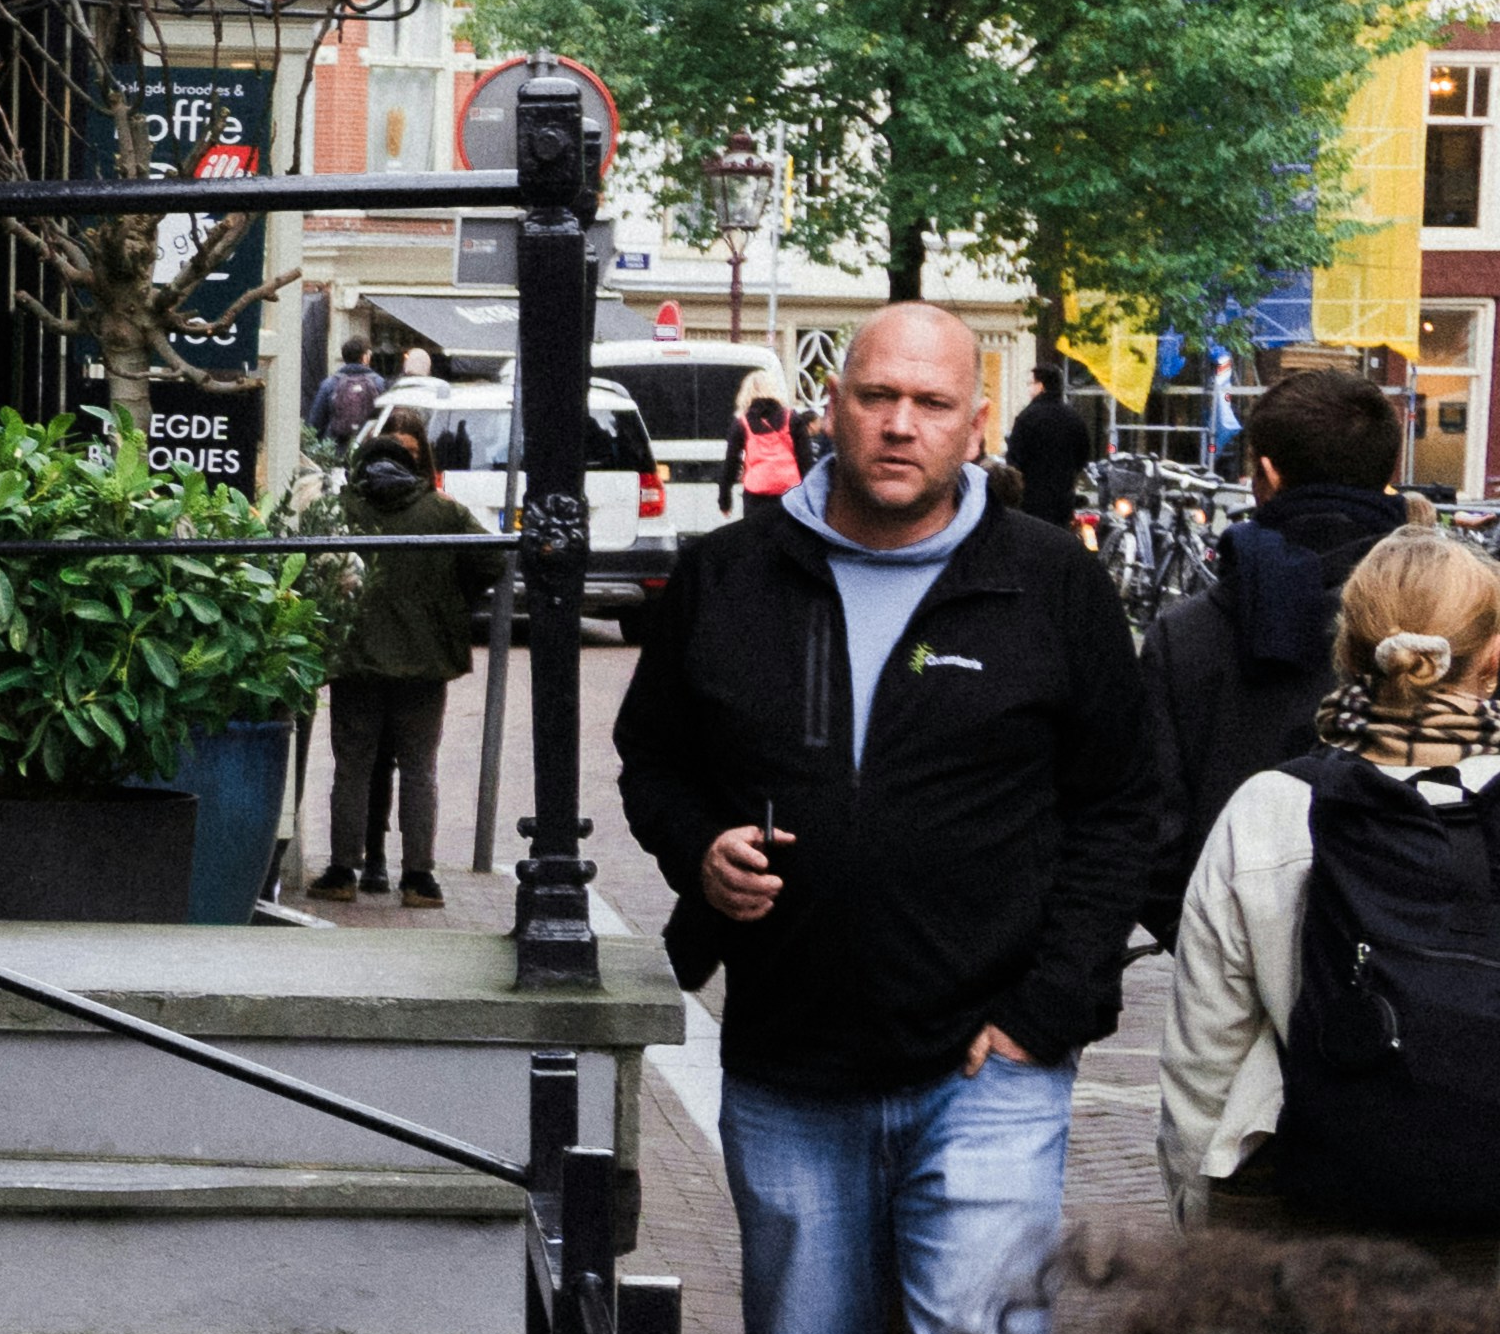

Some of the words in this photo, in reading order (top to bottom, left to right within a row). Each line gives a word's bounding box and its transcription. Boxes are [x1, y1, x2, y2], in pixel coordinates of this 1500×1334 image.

[173, 81, 230, 97] broodes
[233, 83, 244, 97] &
[114, 99, 243, 144] offie
